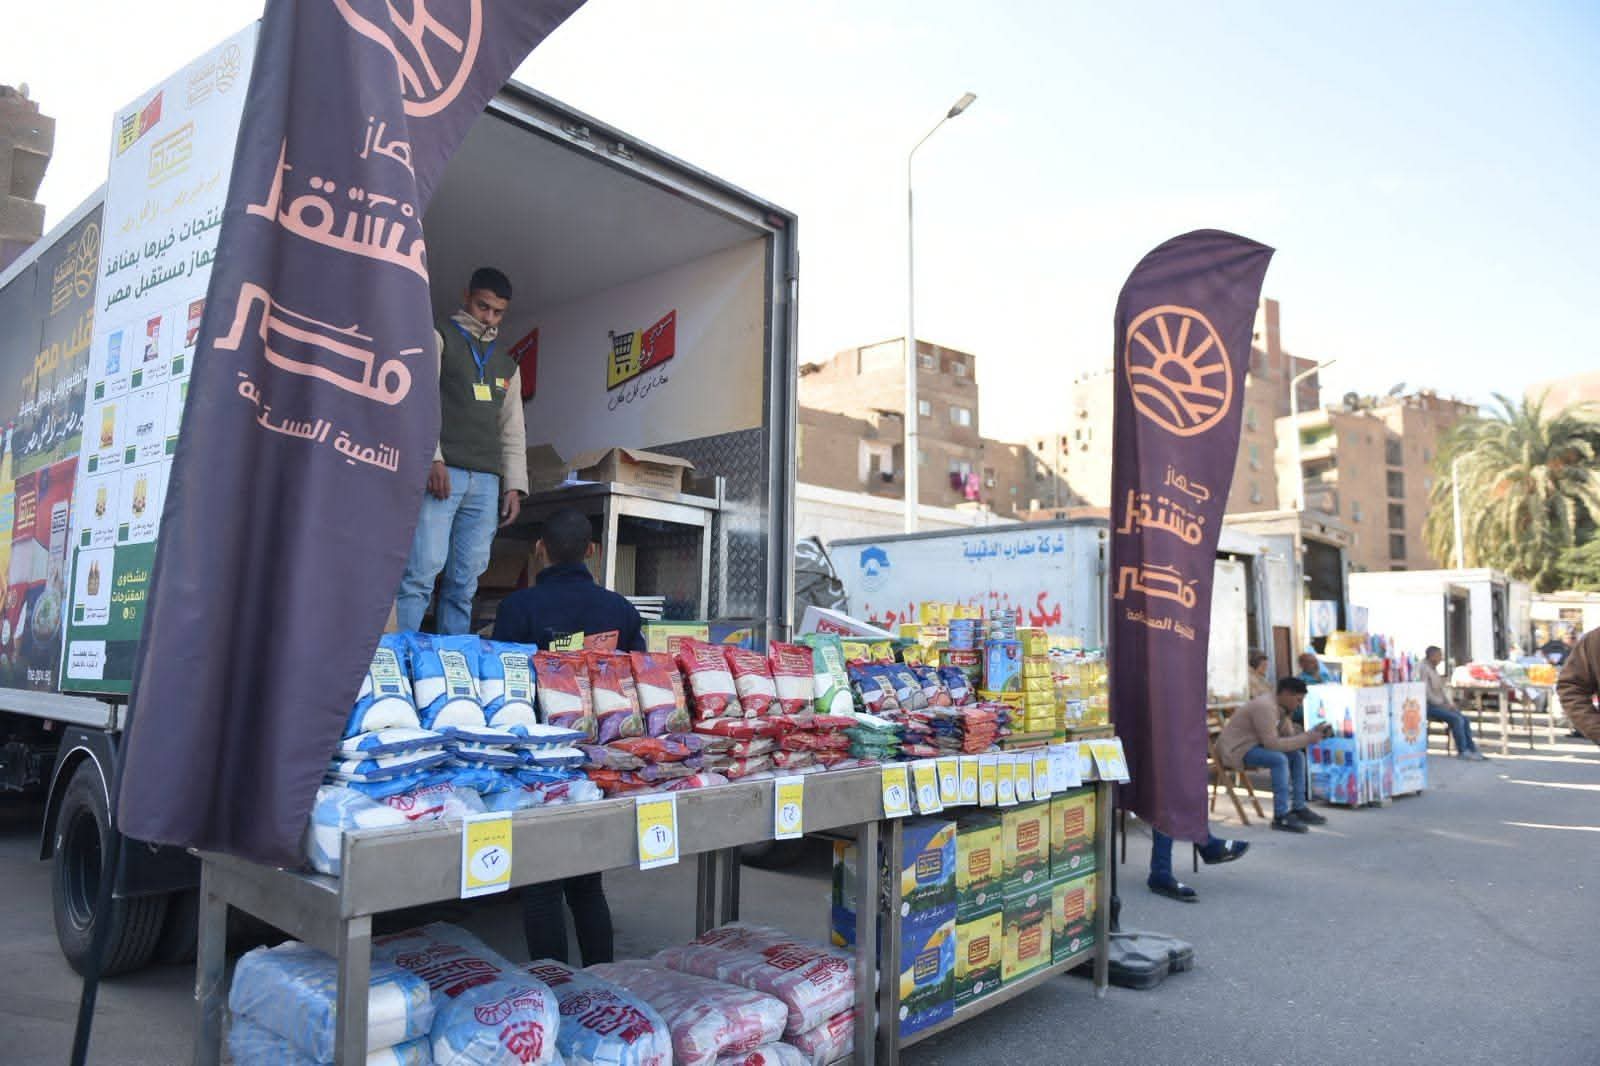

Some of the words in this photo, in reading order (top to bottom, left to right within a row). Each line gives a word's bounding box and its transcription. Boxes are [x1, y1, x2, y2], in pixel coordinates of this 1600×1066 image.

[360, 116, 415, 180] هاز
[179, 205, 224, 241] نتجات
[246, 135, 429, 284] مستقل
[104, 283, 132, 313] مصر
[134, 260, 185, 300] مستقبل
[238, 371, 332, 443] المستة
[1164, 465, 1211, 504] جهاز
[1037, 534, 1065, 556] شركة
